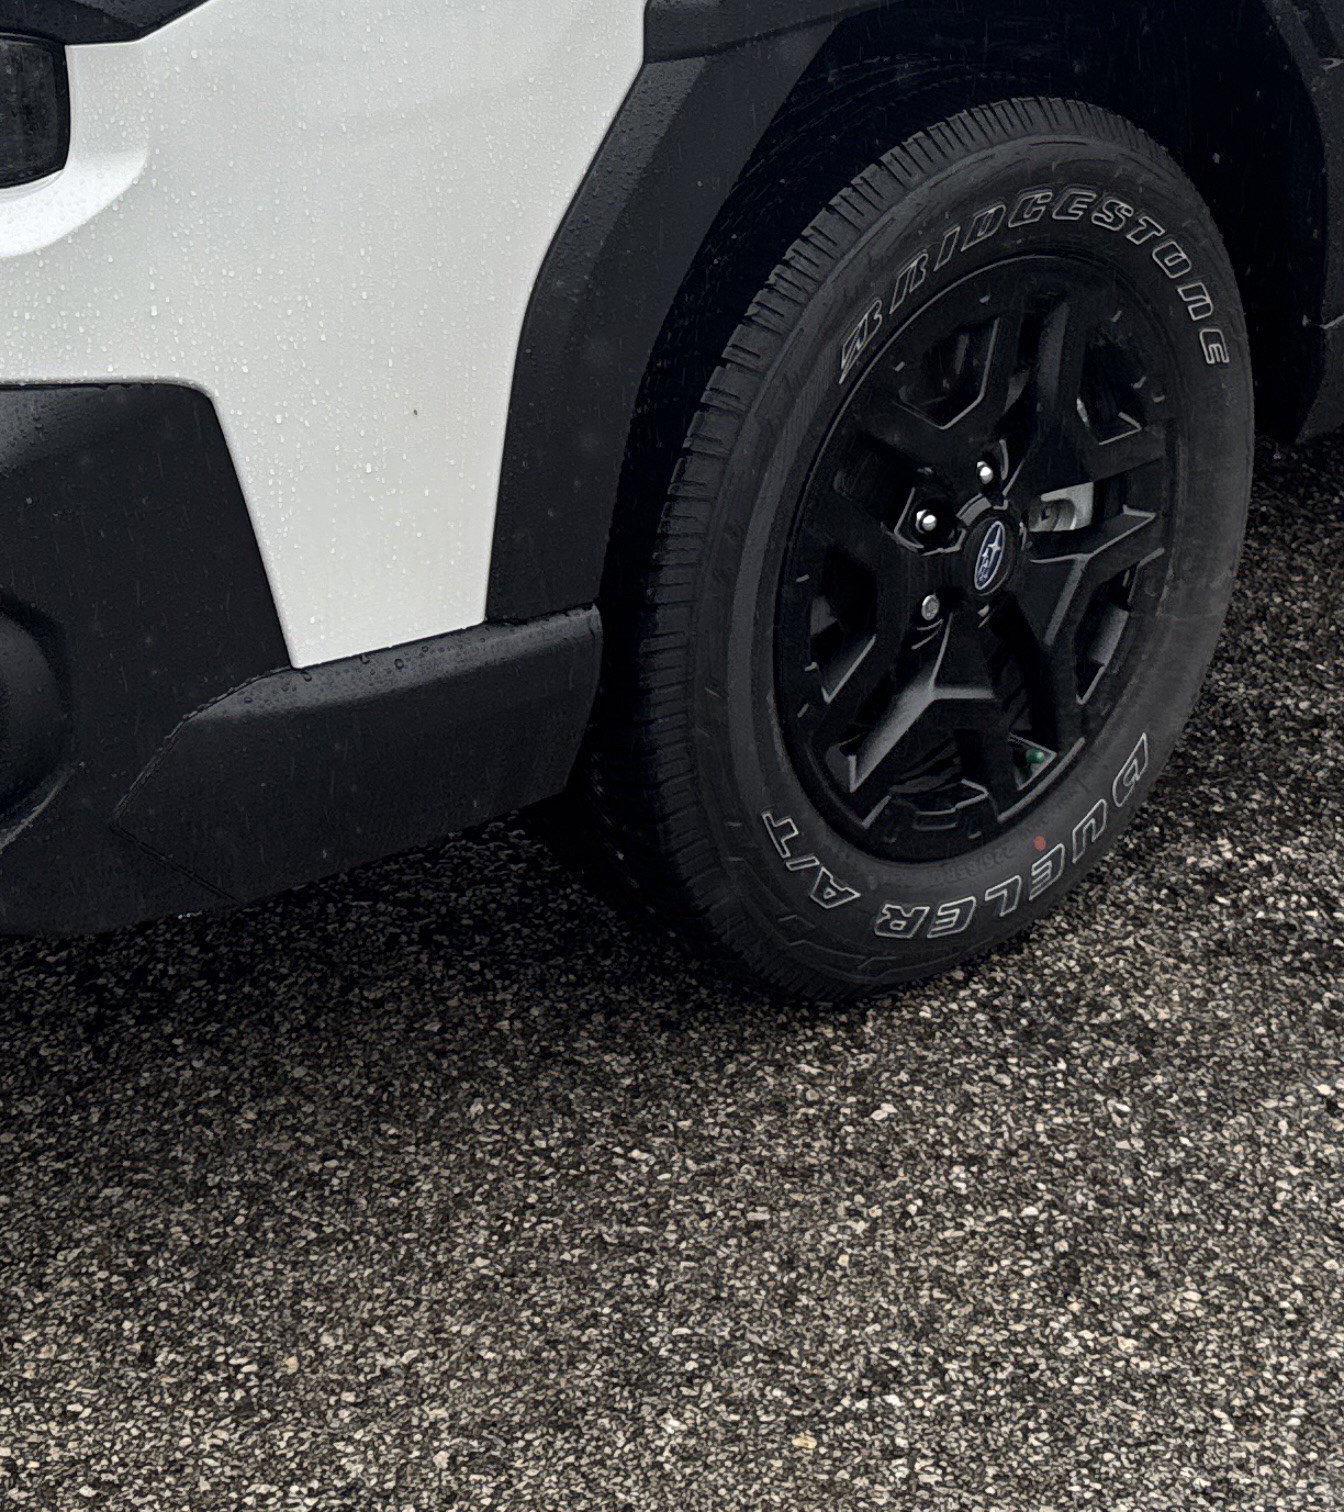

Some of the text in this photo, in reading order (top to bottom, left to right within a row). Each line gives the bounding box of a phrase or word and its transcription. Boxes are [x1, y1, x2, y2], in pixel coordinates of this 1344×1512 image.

[838, 189, 1231, 385] BRIDGESTONE
[761, 810, 862, 909] A/T
[874, 731, 1150, 939] DUELER
